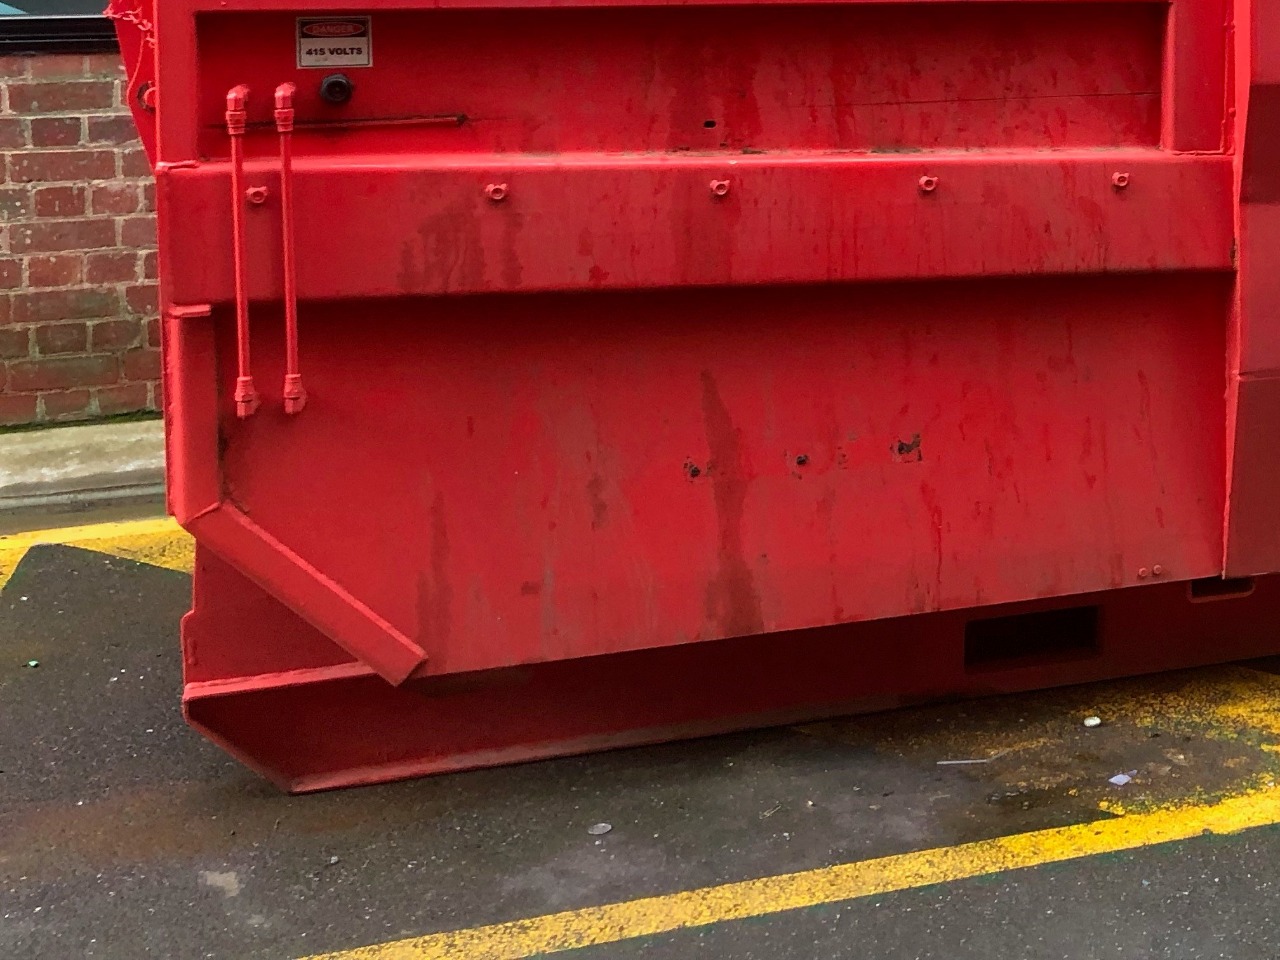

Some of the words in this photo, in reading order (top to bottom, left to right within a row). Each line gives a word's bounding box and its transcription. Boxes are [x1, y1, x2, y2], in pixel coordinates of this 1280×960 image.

[312, 24, 354, 34] DANGER
[305, 47, 325, 56] 415
[327, 47, 363, 56] VOLTS
